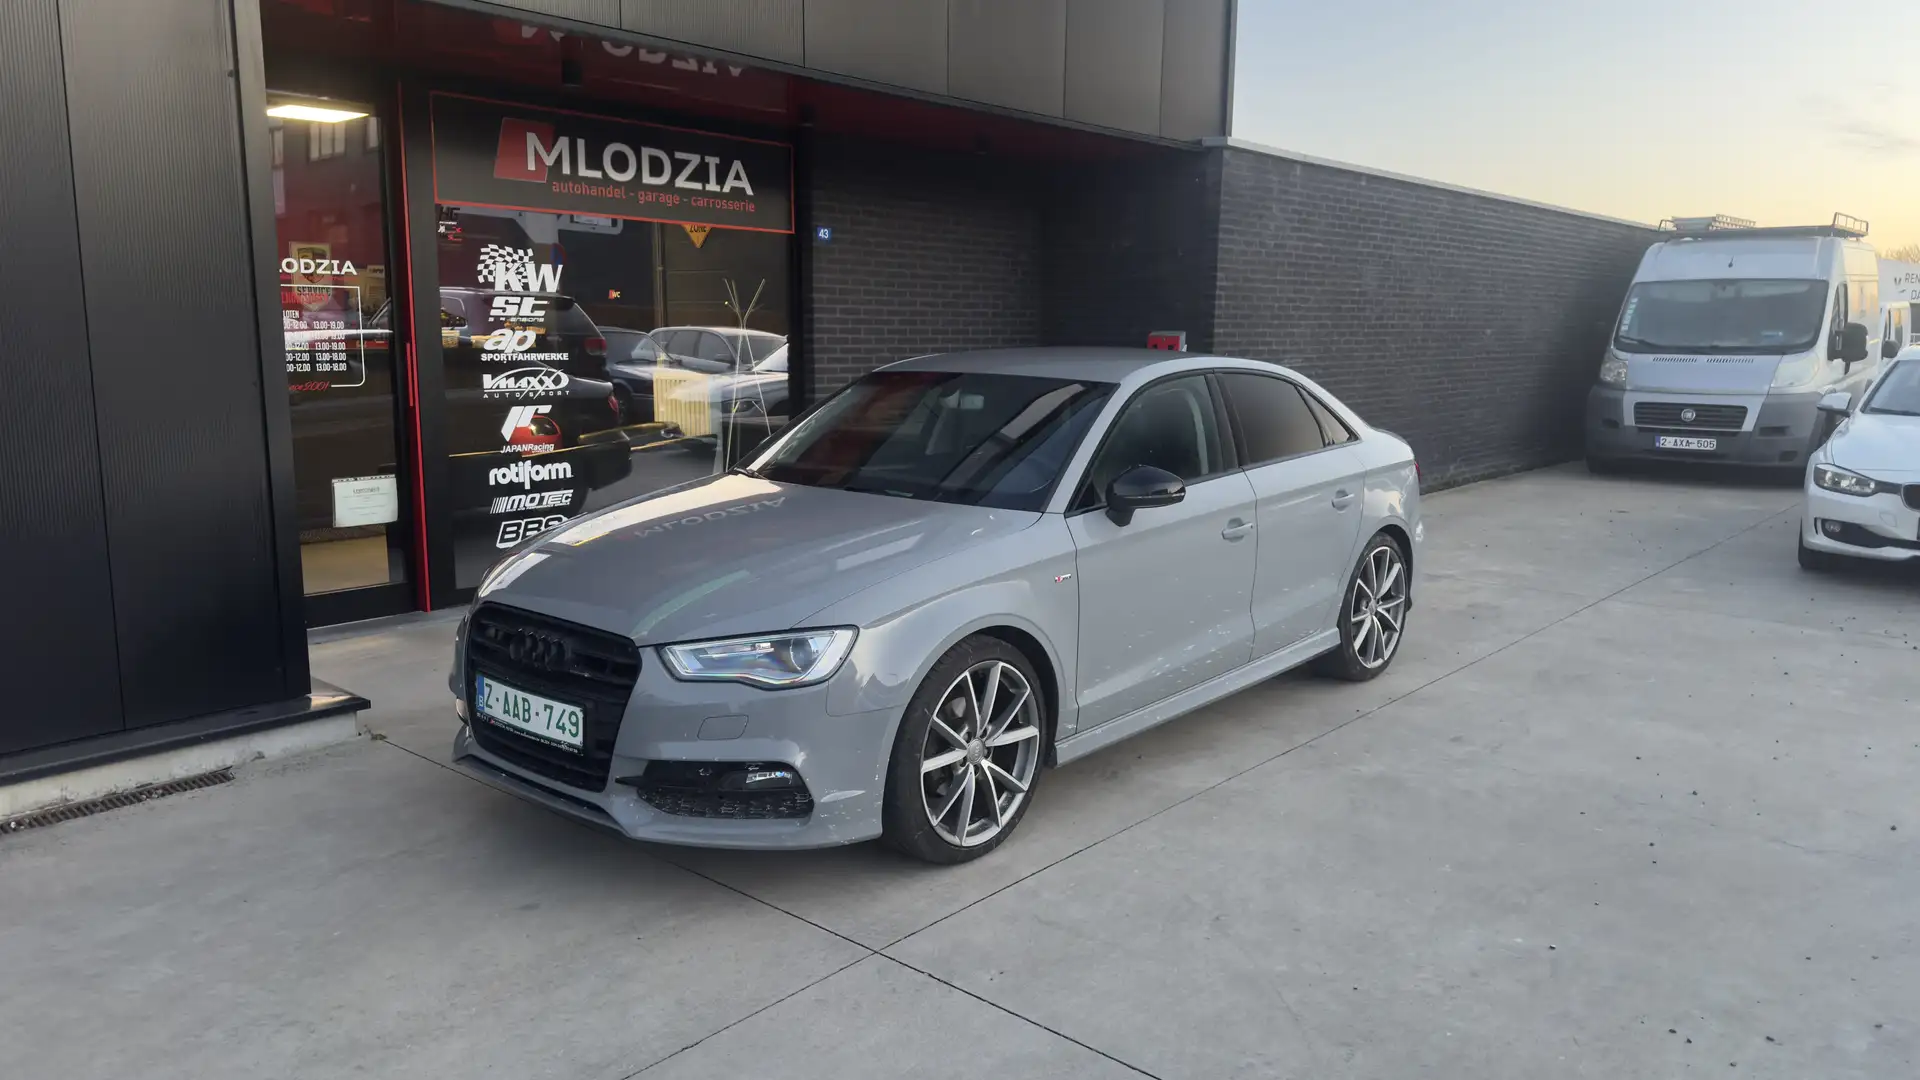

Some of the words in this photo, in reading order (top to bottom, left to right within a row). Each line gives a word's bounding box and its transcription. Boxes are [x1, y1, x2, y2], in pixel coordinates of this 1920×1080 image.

[526, 131, 754, 196] MLODZIA
[552, 180, 626, 199] autohandel
[638, 190, 680, 208] garage
[691, 195, 755, 212] carrosserie
[818, 228, 830, 239] 43
[279, 258, 358, 275] ODZIA
[494, 261, 563, 293] KW
[315, 342, 346, 351] 13.00-19.00
[484, 329, 537, 354] ap
[316, 353, 347, 361] 13.00-18.00
[481, 353, 569, 361] SPORTFAHRWERKE
[316, 363, 347, 371] 13.00-18.00
[489, 460, 572, 490] rotiform
